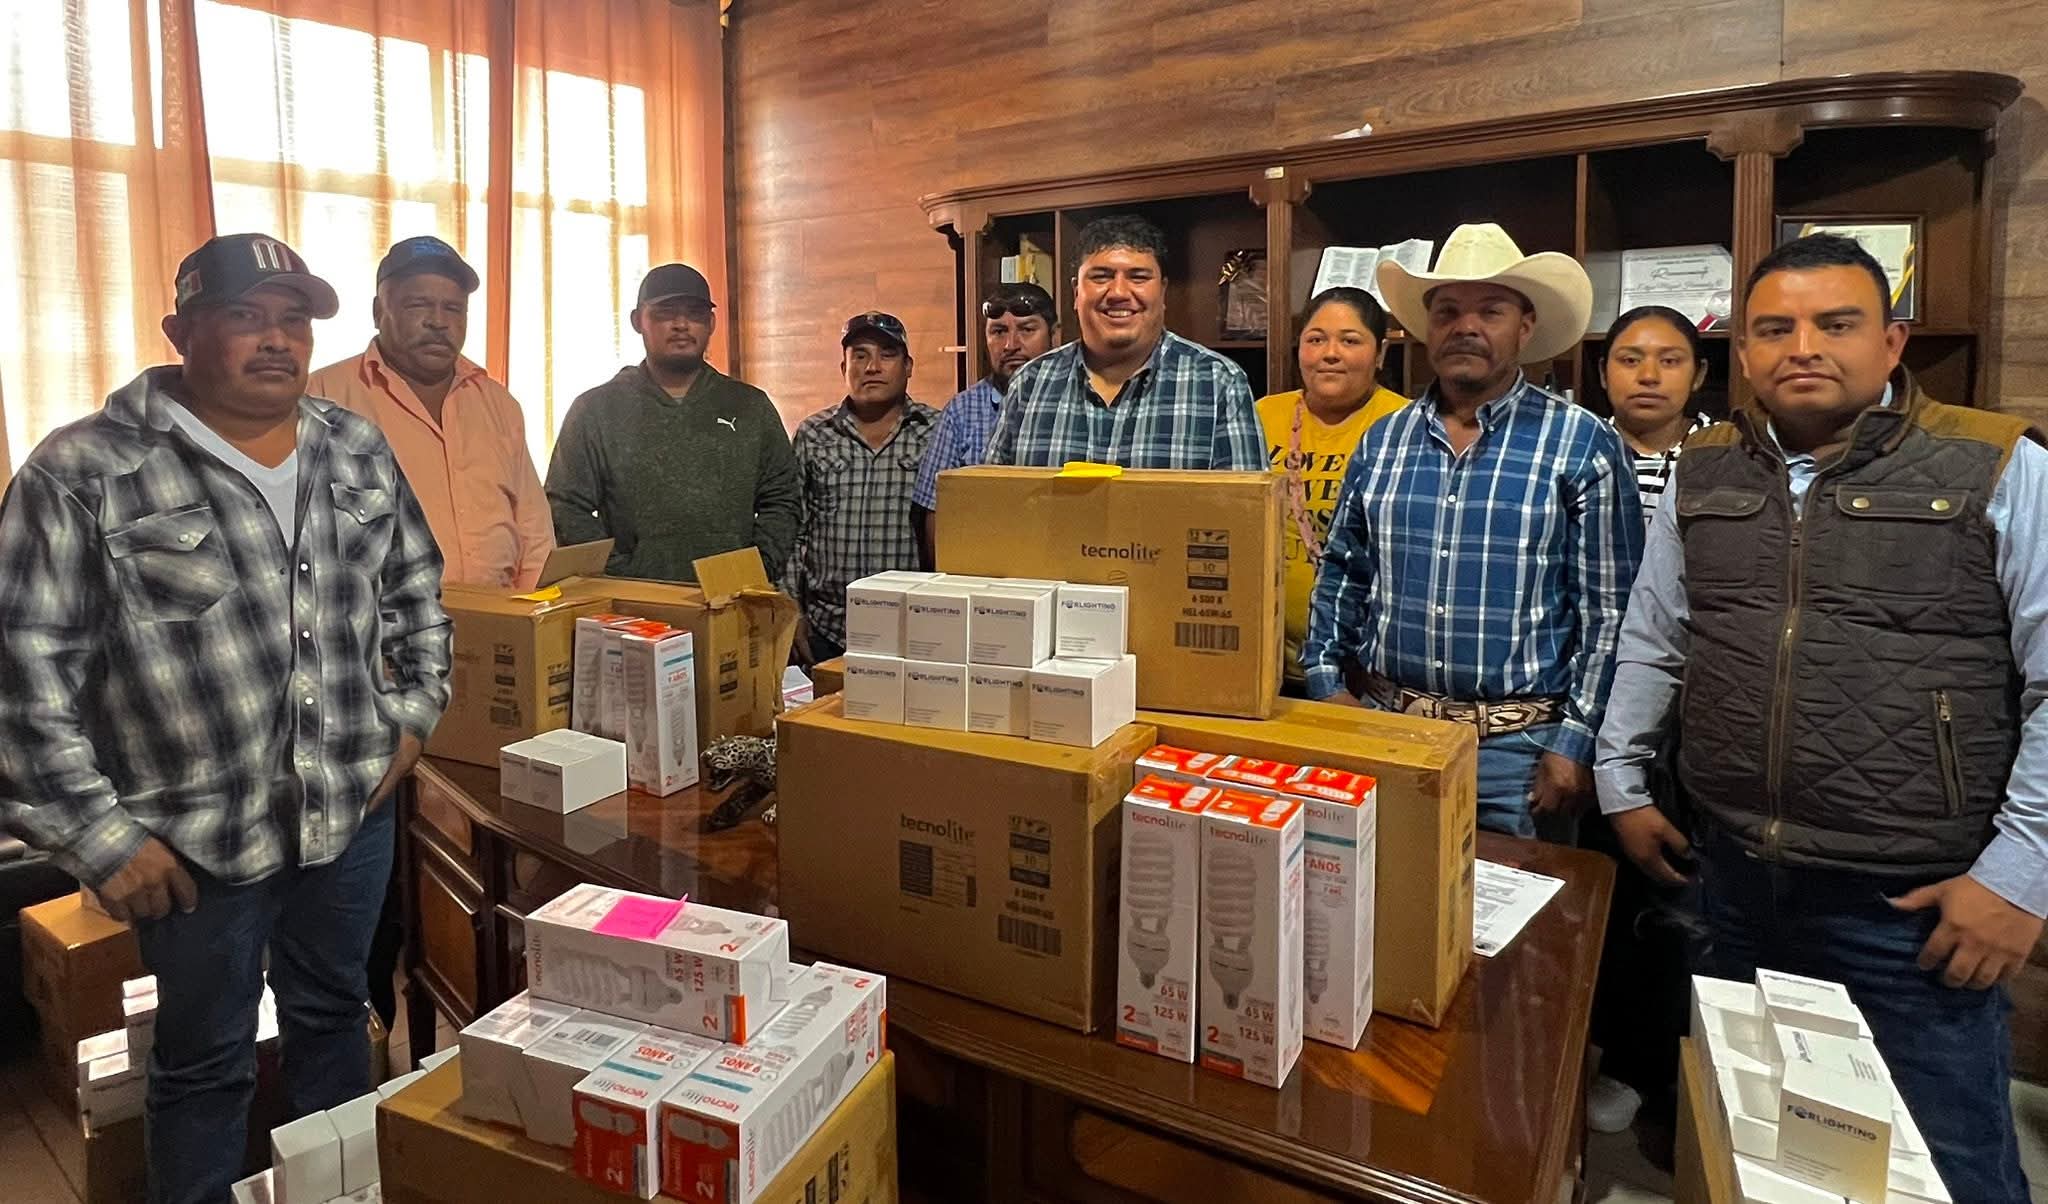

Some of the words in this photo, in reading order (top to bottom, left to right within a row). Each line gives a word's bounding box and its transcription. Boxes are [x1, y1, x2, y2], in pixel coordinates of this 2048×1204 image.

[1081, 542, 1160, 561] tecnolite
[1217, 801, 1233, 809] 2
[901, 814, 974, 842] tecnolite
[719, 943, 739, 952] 2
[854, 979, 870, 989] 2
[1161, 984, 1175, 997] 65
[1177, 988, 1188, 1001] W
[703, 1015, 718, 1031] 2
[1123, 1005, 1136, 1023] 2
[1153, 1005, 1174, 1020] 125
[1177, 1010, 1188, 1023] W
[1207, 1026, 1219, 1044] 2
[1240, 1026, 1260, 1042] 125
[592, 1079, 649, 1099] tecnolite
[682, 1088, 740, 1114] tecnolite
[1787, 1103, 1877, 1142] FORLIGHTING
[607, 1168, 625, 1186] 2
[696, 1180, 715, 1199] 2
